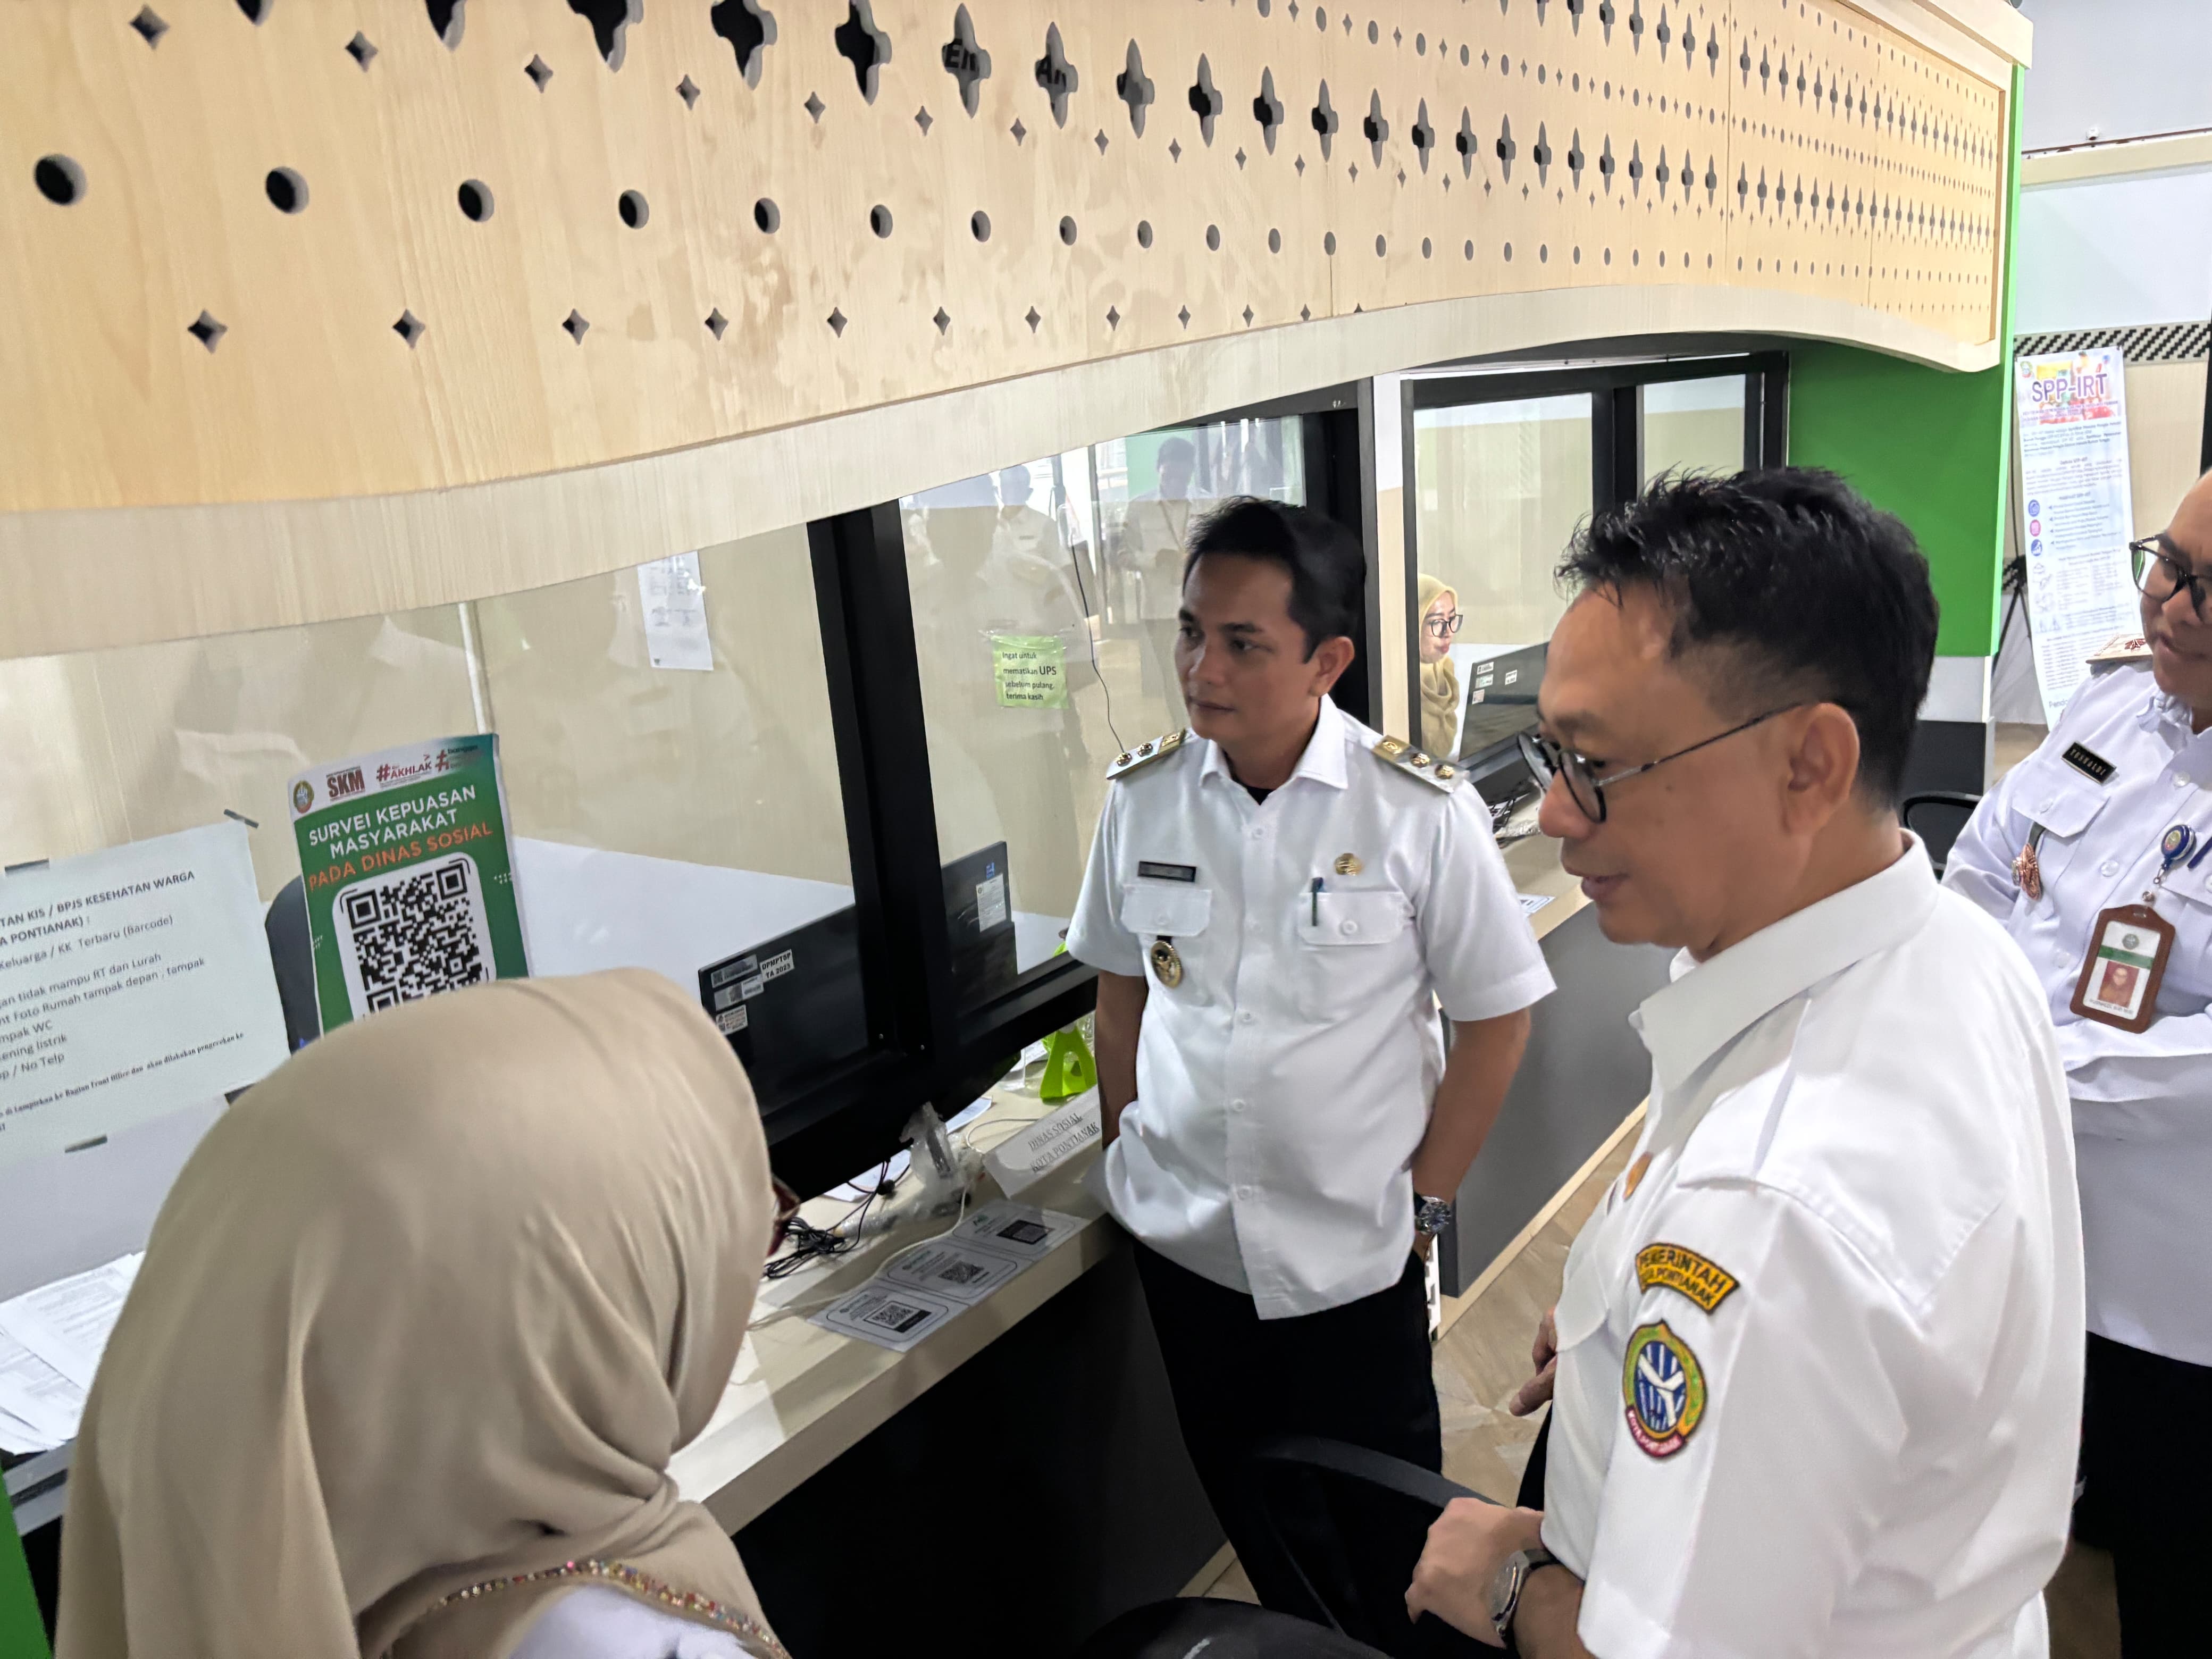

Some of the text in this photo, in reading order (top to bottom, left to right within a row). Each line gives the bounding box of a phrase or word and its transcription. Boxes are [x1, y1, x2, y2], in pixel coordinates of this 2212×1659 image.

[2032, 373, 2107, 403] SPP-IRT
[1039, 666, 1057, 675] UPS
[327, 769, 365, 798] SKM
[309, 785, 476, 846] SURVEI KEPUASAN
[330, 809, 457, 859] MASYARAKAT
[309, 821, 493, 892] PADA DINAS SOSIAL
[28, 908, 45, 921] KIS
[49, 904, 53, 918] /
[57, 898, 83, 913] BPJS
[86, 882, 151, 906] KESEHATAN
[153, 870, 195, 890] WARGA
[58, 941, 71, 954] KK
[78, 932, 120, 948] Terbaru
[123, 914, 173, 939] (Barcode)
[14, 1007, 39, 1021] Foto
[43, 994, 81, 1012] Rumah
[83, 981, 123, 1000] tampak
[125, 971, 158, 987] depan
[167, 958, 205, 975] tampak
[19, 987, 46, 1002] tidak
[49, 974, 91, 992] mampu
[93, 968, 105, 980] RT
[110, 962, 129, 975] dan
[133, 953, 161, 968] Lurah
[766, 970, 774, 979] TA
[776, 963, 791, 974] 2023
[32, 1020, 53, 1033] WC
[37, 1034, 67, 1050] listrik
[21, 1063, 37, 1073] No
[40, 1053, 64, 1067] Telp
[91, 1076, 109, 1089] Front
[111, 1071, 130, 1083] Office
[131, 1066, 144, 1075] dan
[147, 1059, 163, 1069] akan
[164, 1049, 196, 1063] dilakukan
[1027, 1112, 1083, 1152] DINAS SOSIAL
[1030, 1122, 1100, 1174] KOTA PONTIANAK
